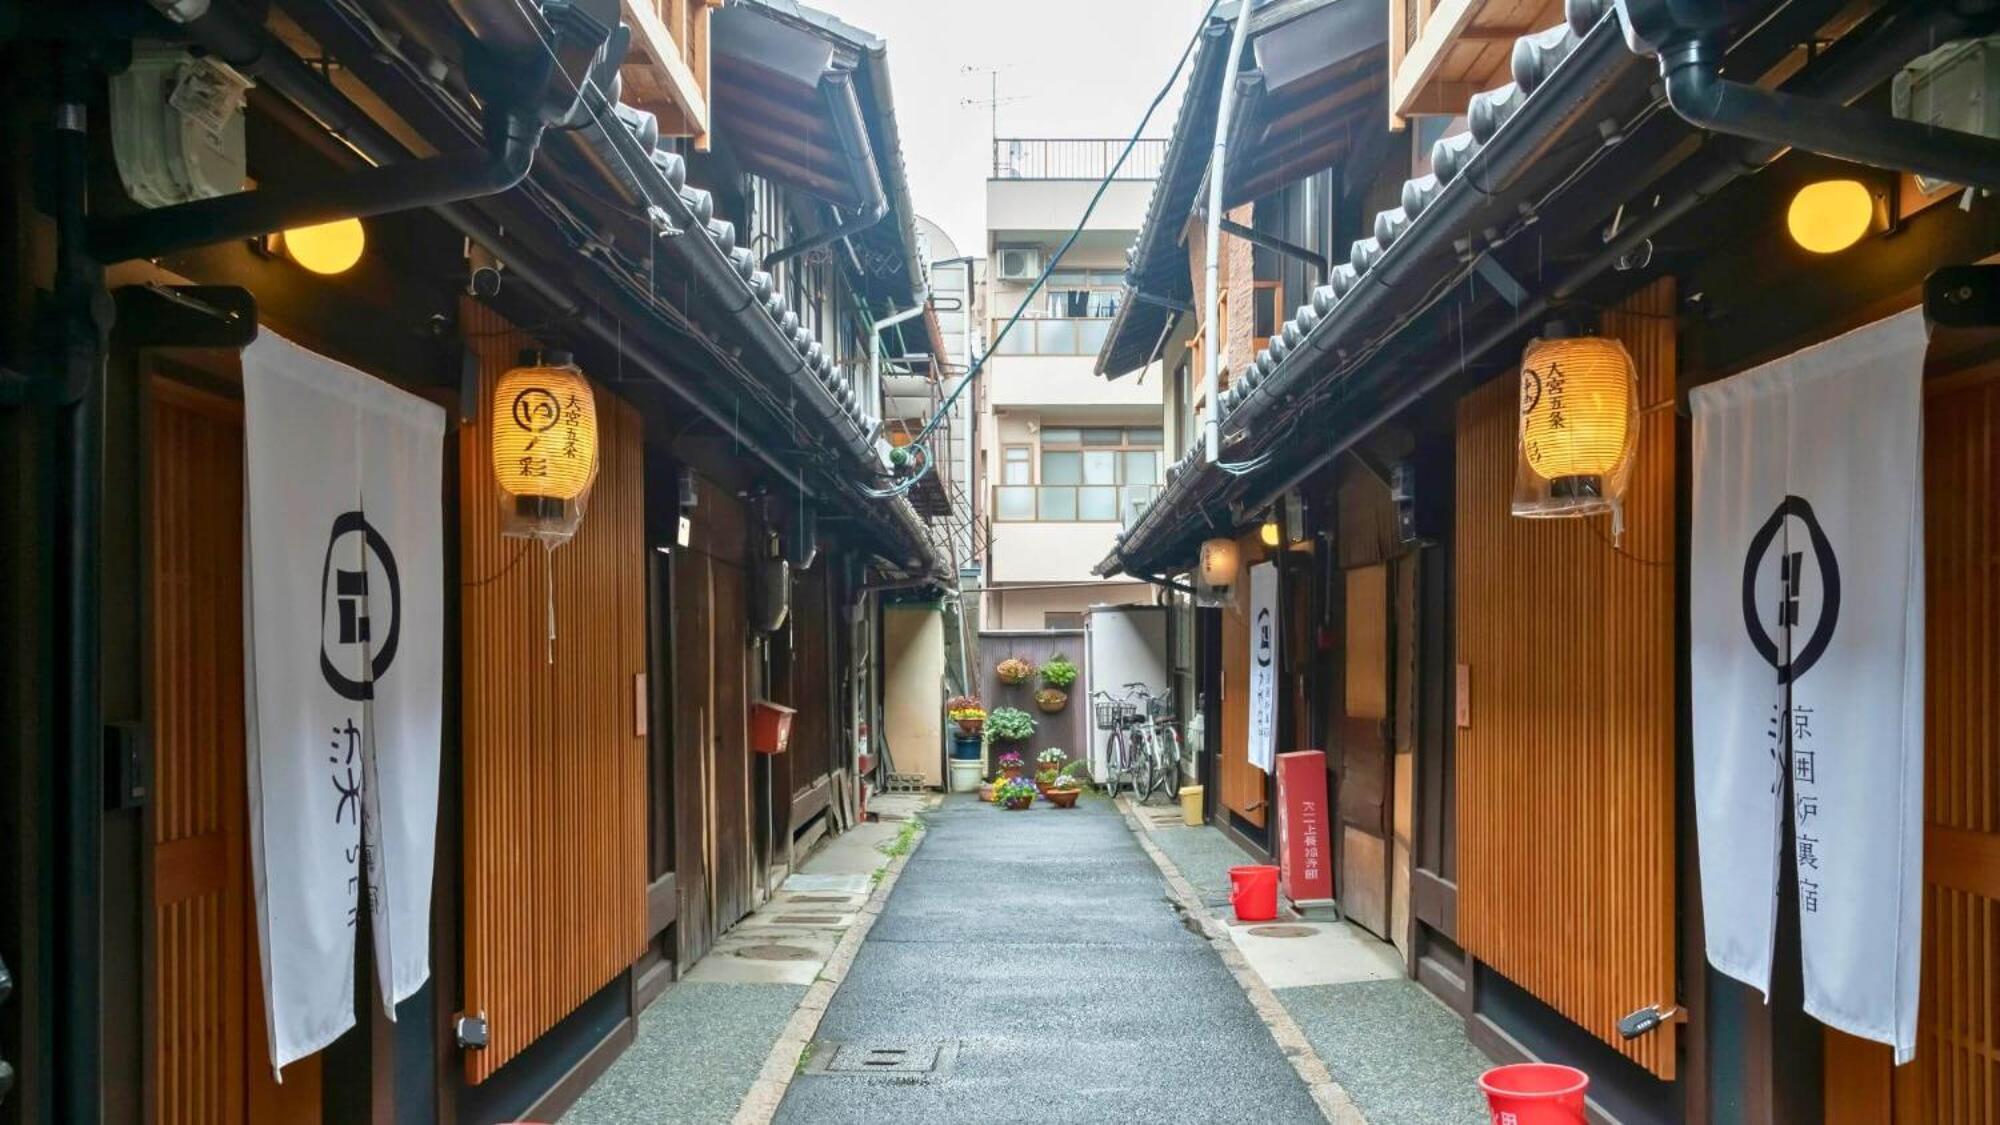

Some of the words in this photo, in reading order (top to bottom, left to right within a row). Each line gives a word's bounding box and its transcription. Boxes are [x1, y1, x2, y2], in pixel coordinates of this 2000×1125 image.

[563, 394, 581, 459] 大宮五条
[1546, 362, 1565, 429] 大宮五条
